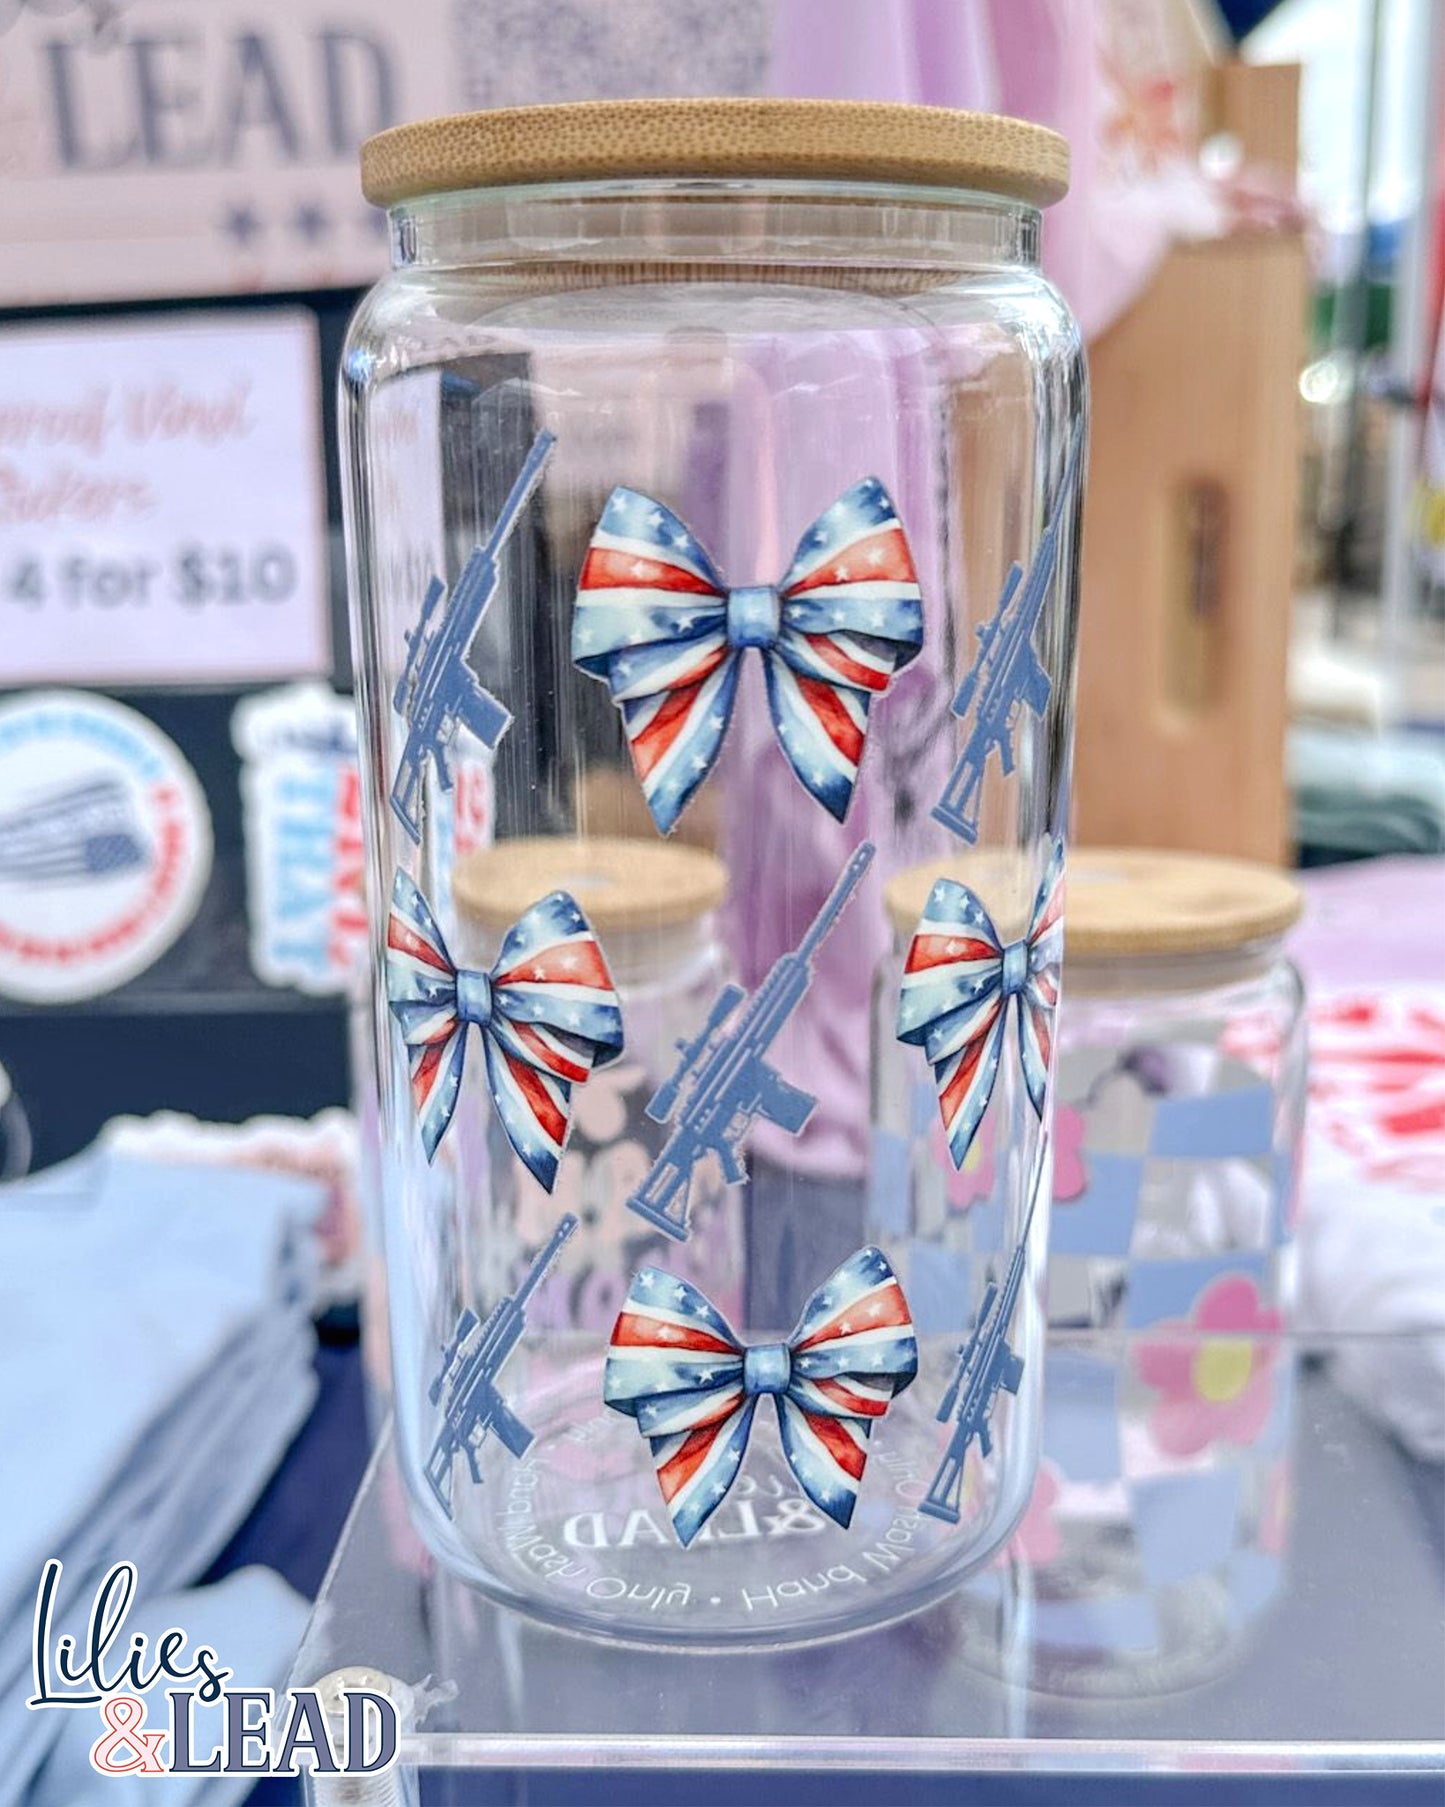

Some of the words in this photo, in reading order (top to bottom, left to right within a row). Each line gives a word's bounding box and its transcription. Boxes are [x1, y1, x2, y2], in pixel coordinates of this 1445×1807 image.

[43, 26, 397, 170] LEAD
[9, 555, 45, 609] 4
[57, 545, 160, 609] for
[174, 540, 299, 613] $10
